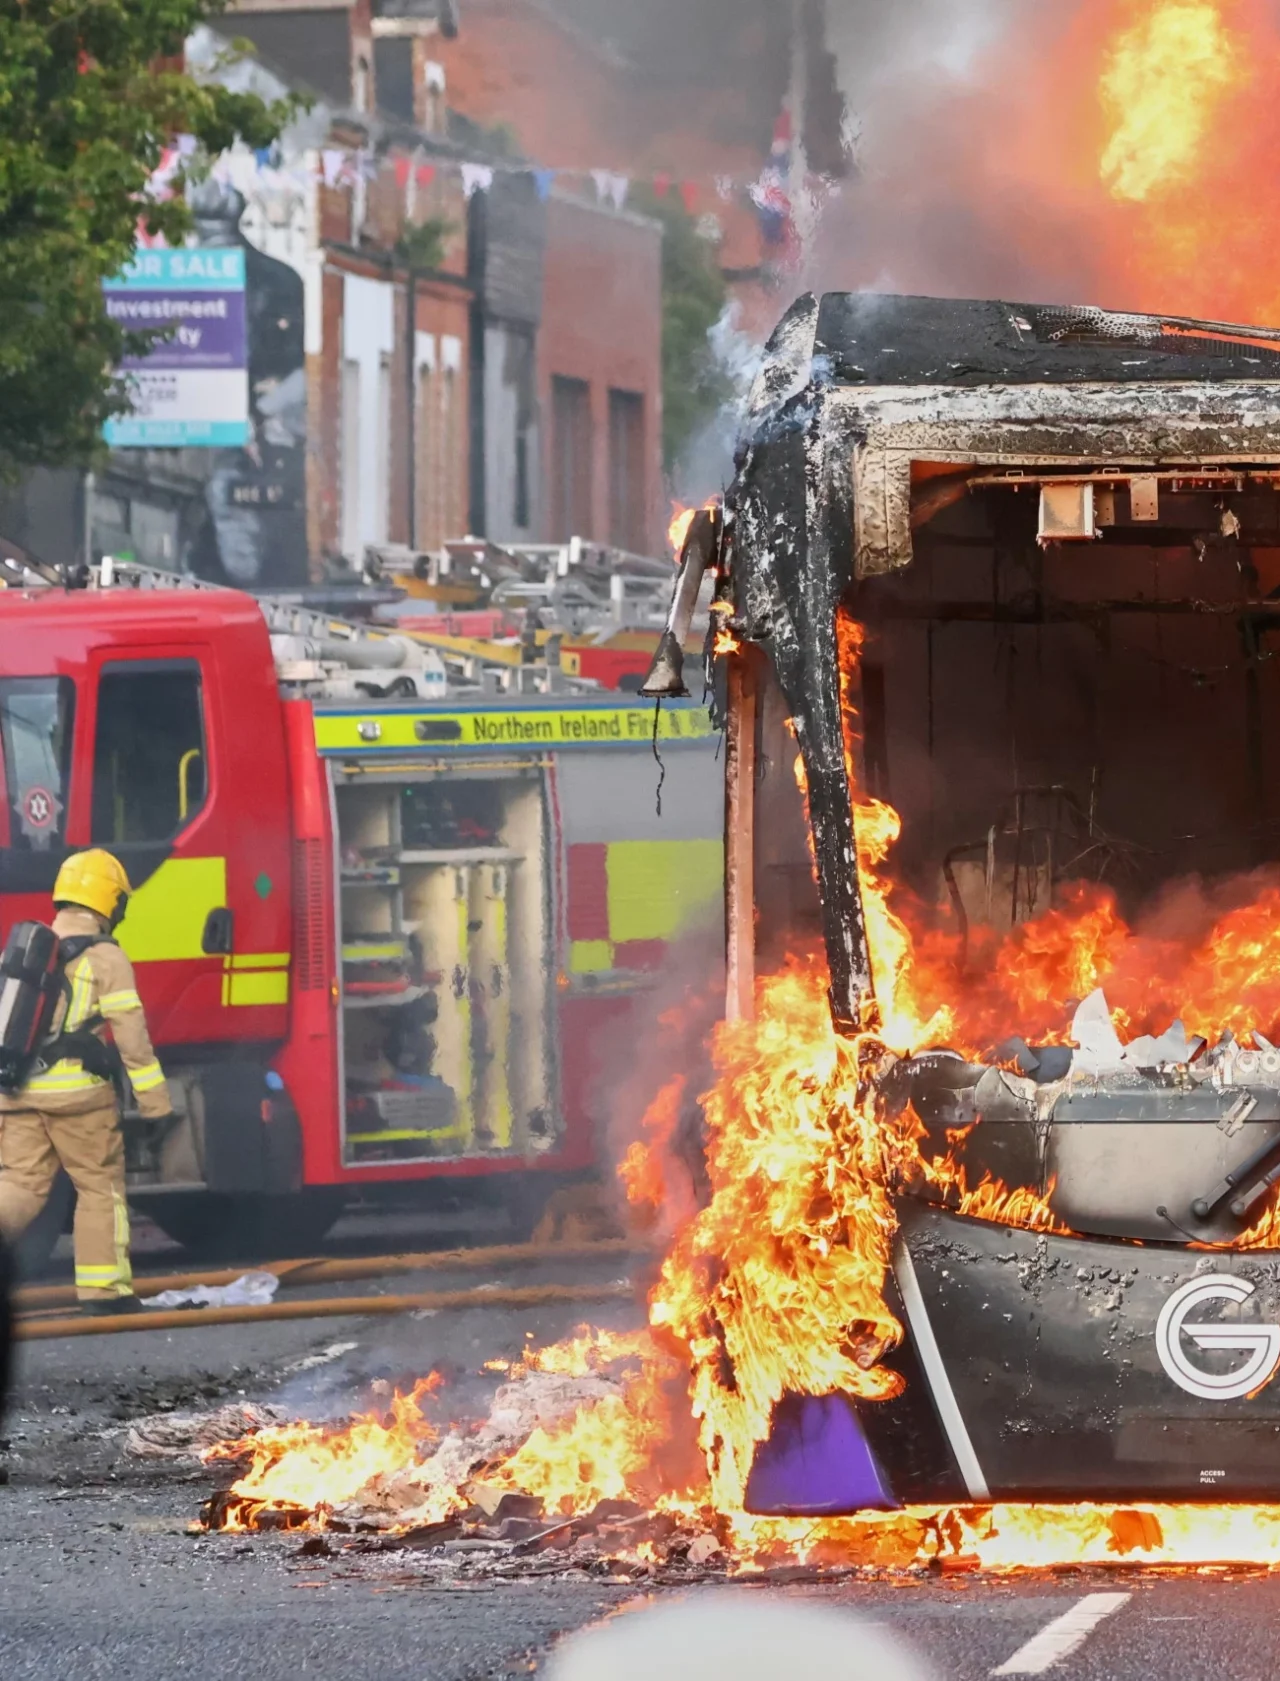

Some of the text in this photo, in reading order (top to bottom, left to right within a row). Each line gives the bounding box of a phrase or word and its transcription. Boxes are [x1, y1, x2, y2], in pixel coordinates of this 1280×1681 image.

[169, 254, 239, 278] SALE
[106, 298, 227, 319] Investment
[473, 715, 553, 740] Northern
[559, 713, 621, 738] Ireland
